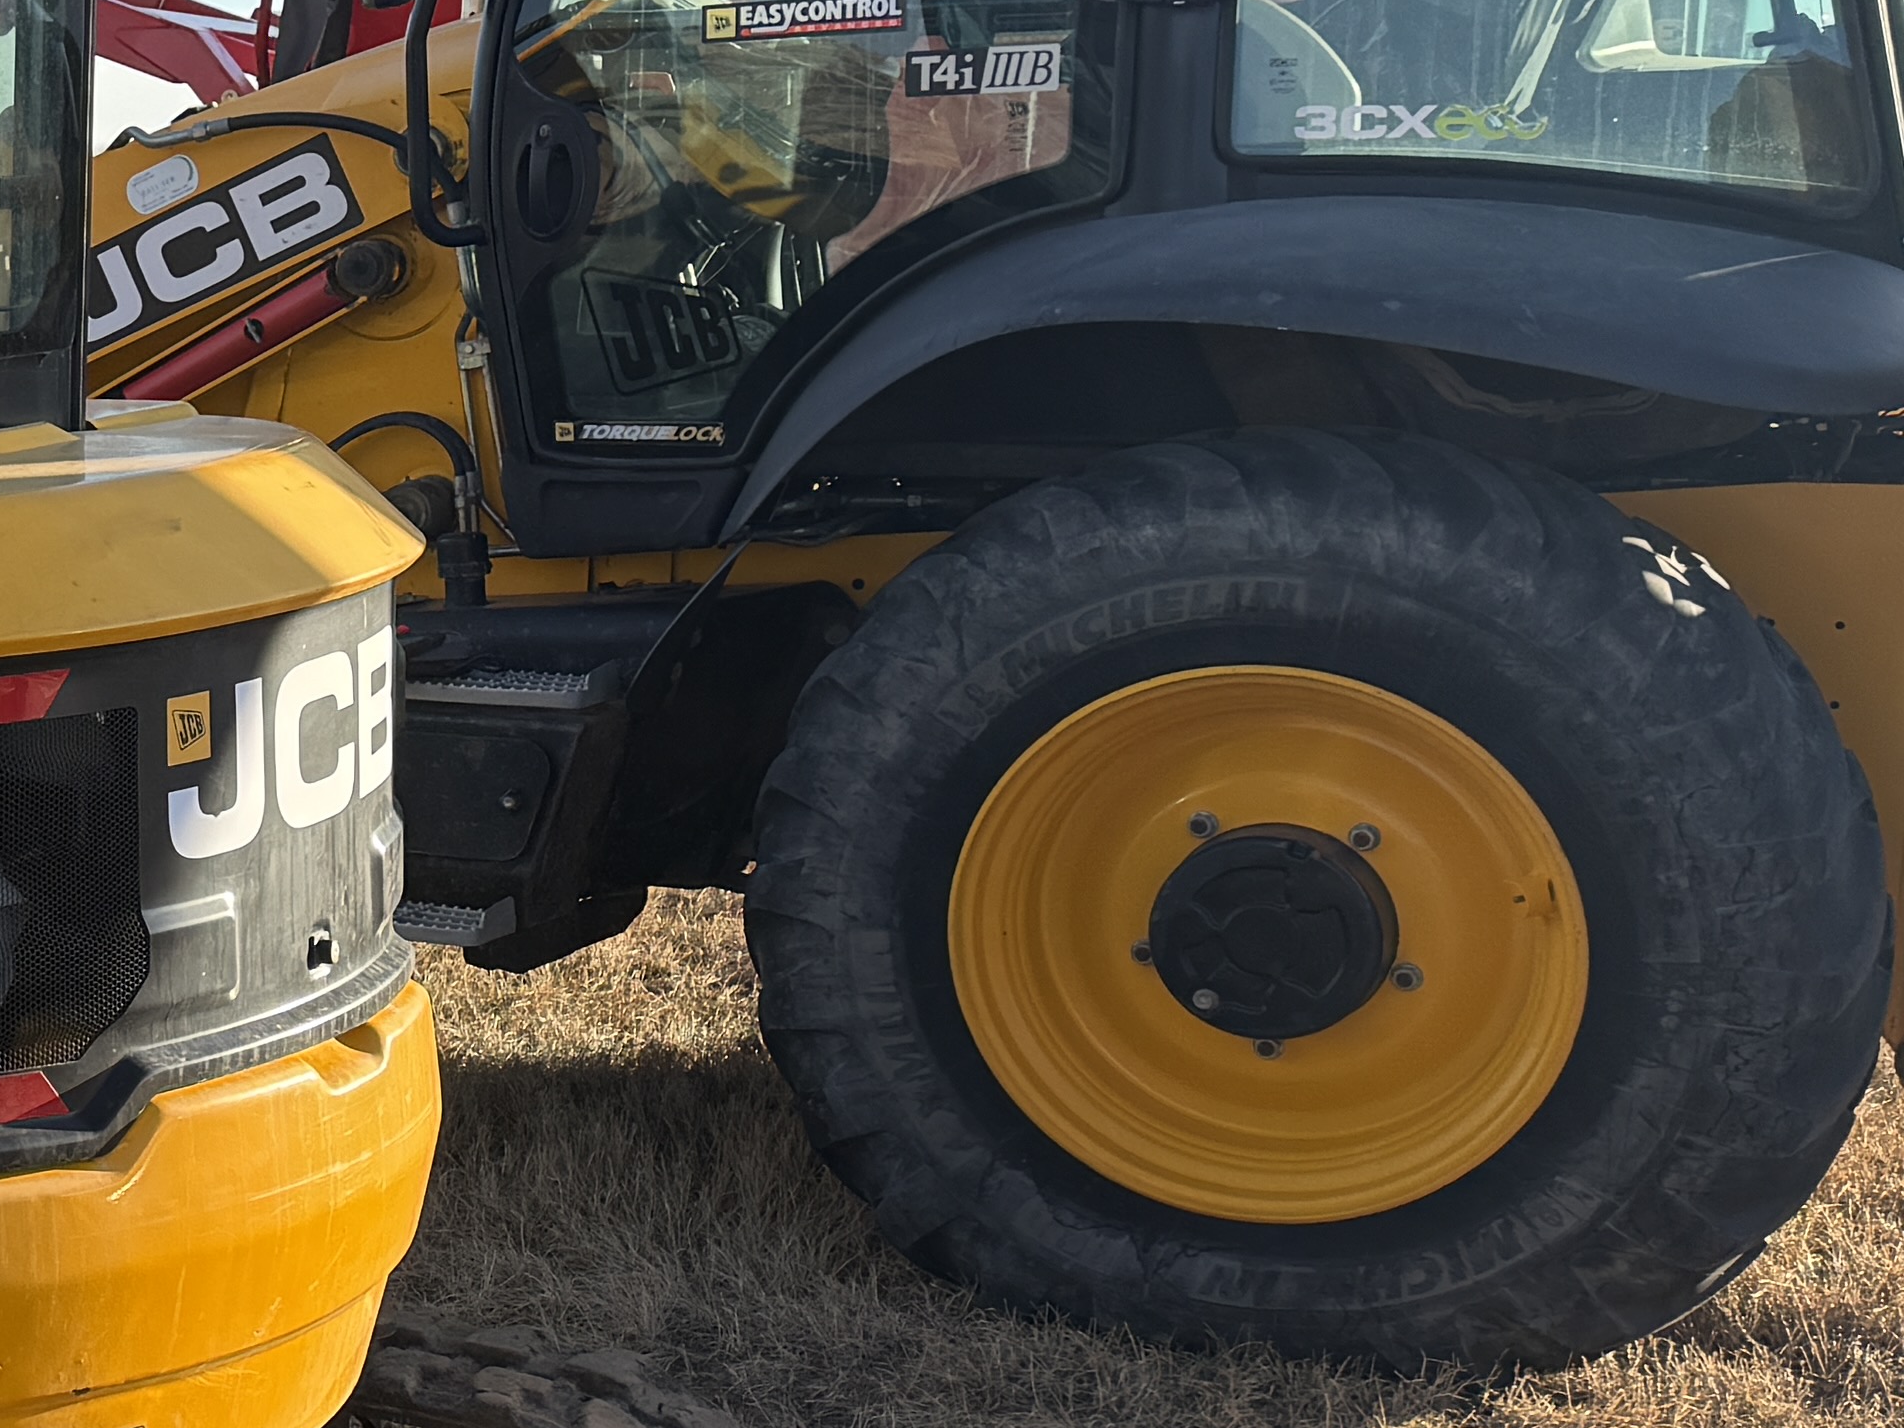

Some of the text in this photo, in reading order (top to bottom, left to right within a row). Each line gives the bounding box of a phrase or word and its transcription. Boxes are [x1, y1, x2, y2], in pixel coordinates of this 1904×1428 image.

[911, 53, 978, 92] T4i
[88, 152, 349, 343] JCB
[610, 281, 730, 381] JCB
[580, 424, 725, 442] TORQUELOCK
[167, 625, 394, 861] JCB
[174, 709, 205, 755] JCB
